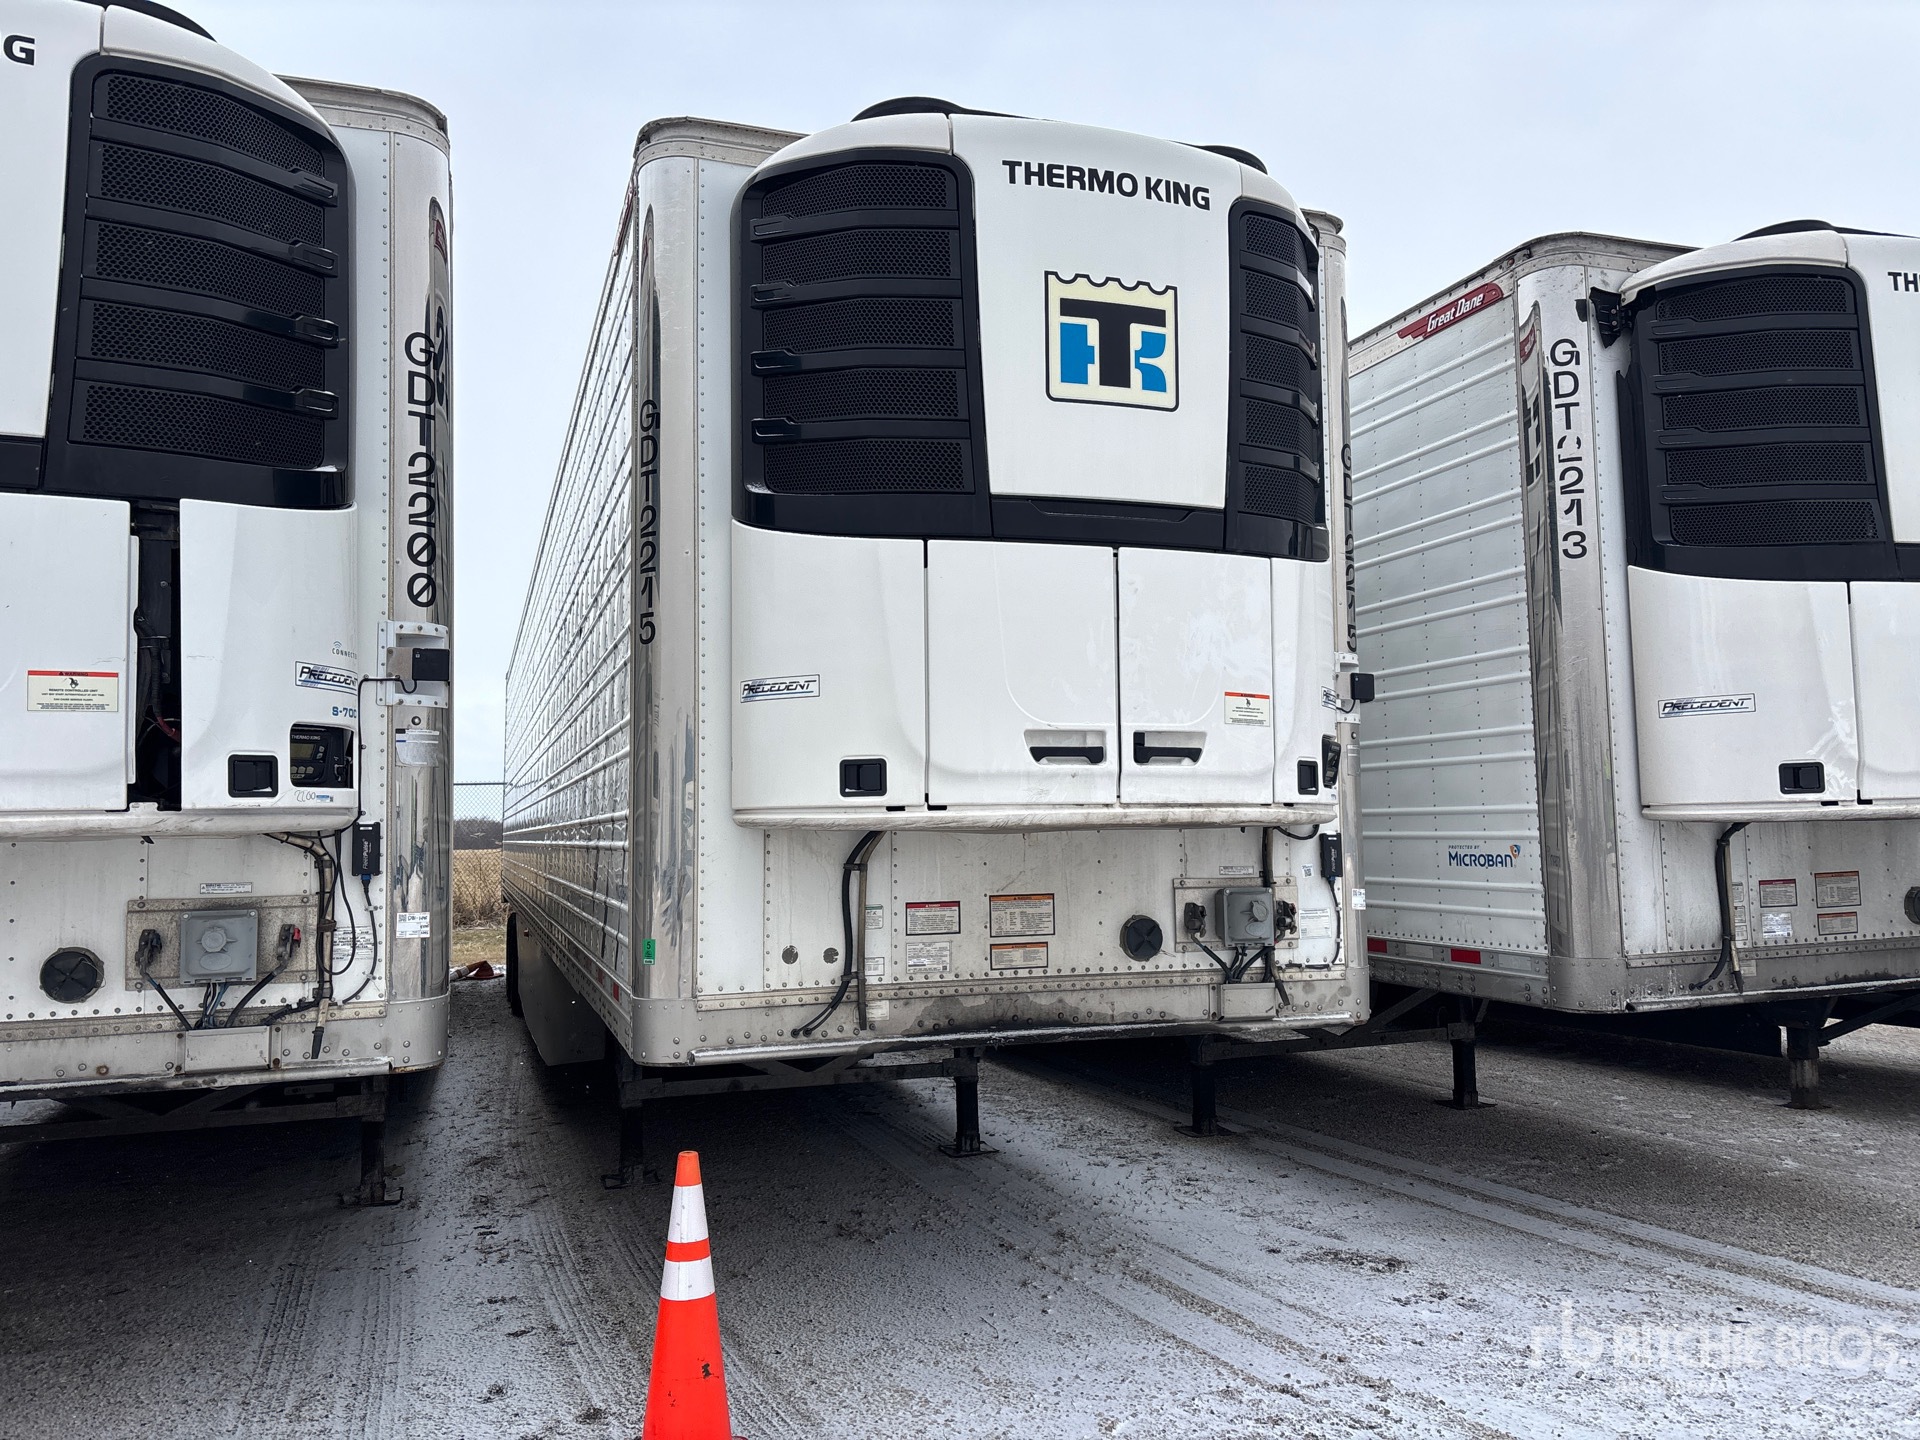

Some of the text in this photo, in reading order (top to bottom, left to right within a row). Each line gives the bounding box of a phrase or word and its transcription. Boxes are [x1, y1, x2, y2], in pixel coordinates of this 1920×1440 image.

[1001, 159, 1211, 211] THERMO KING
[1887, 271, 1920, 292] TH
[1426, 292, 1485, 333] Great Dane
[742, 679, 817, 696] PRECEDENT
[1662, 698, 1752, 712] PRECEDENT
[1448, 850, 1514, 868] MICROBAN
[646, 941, 652, 950] 5
